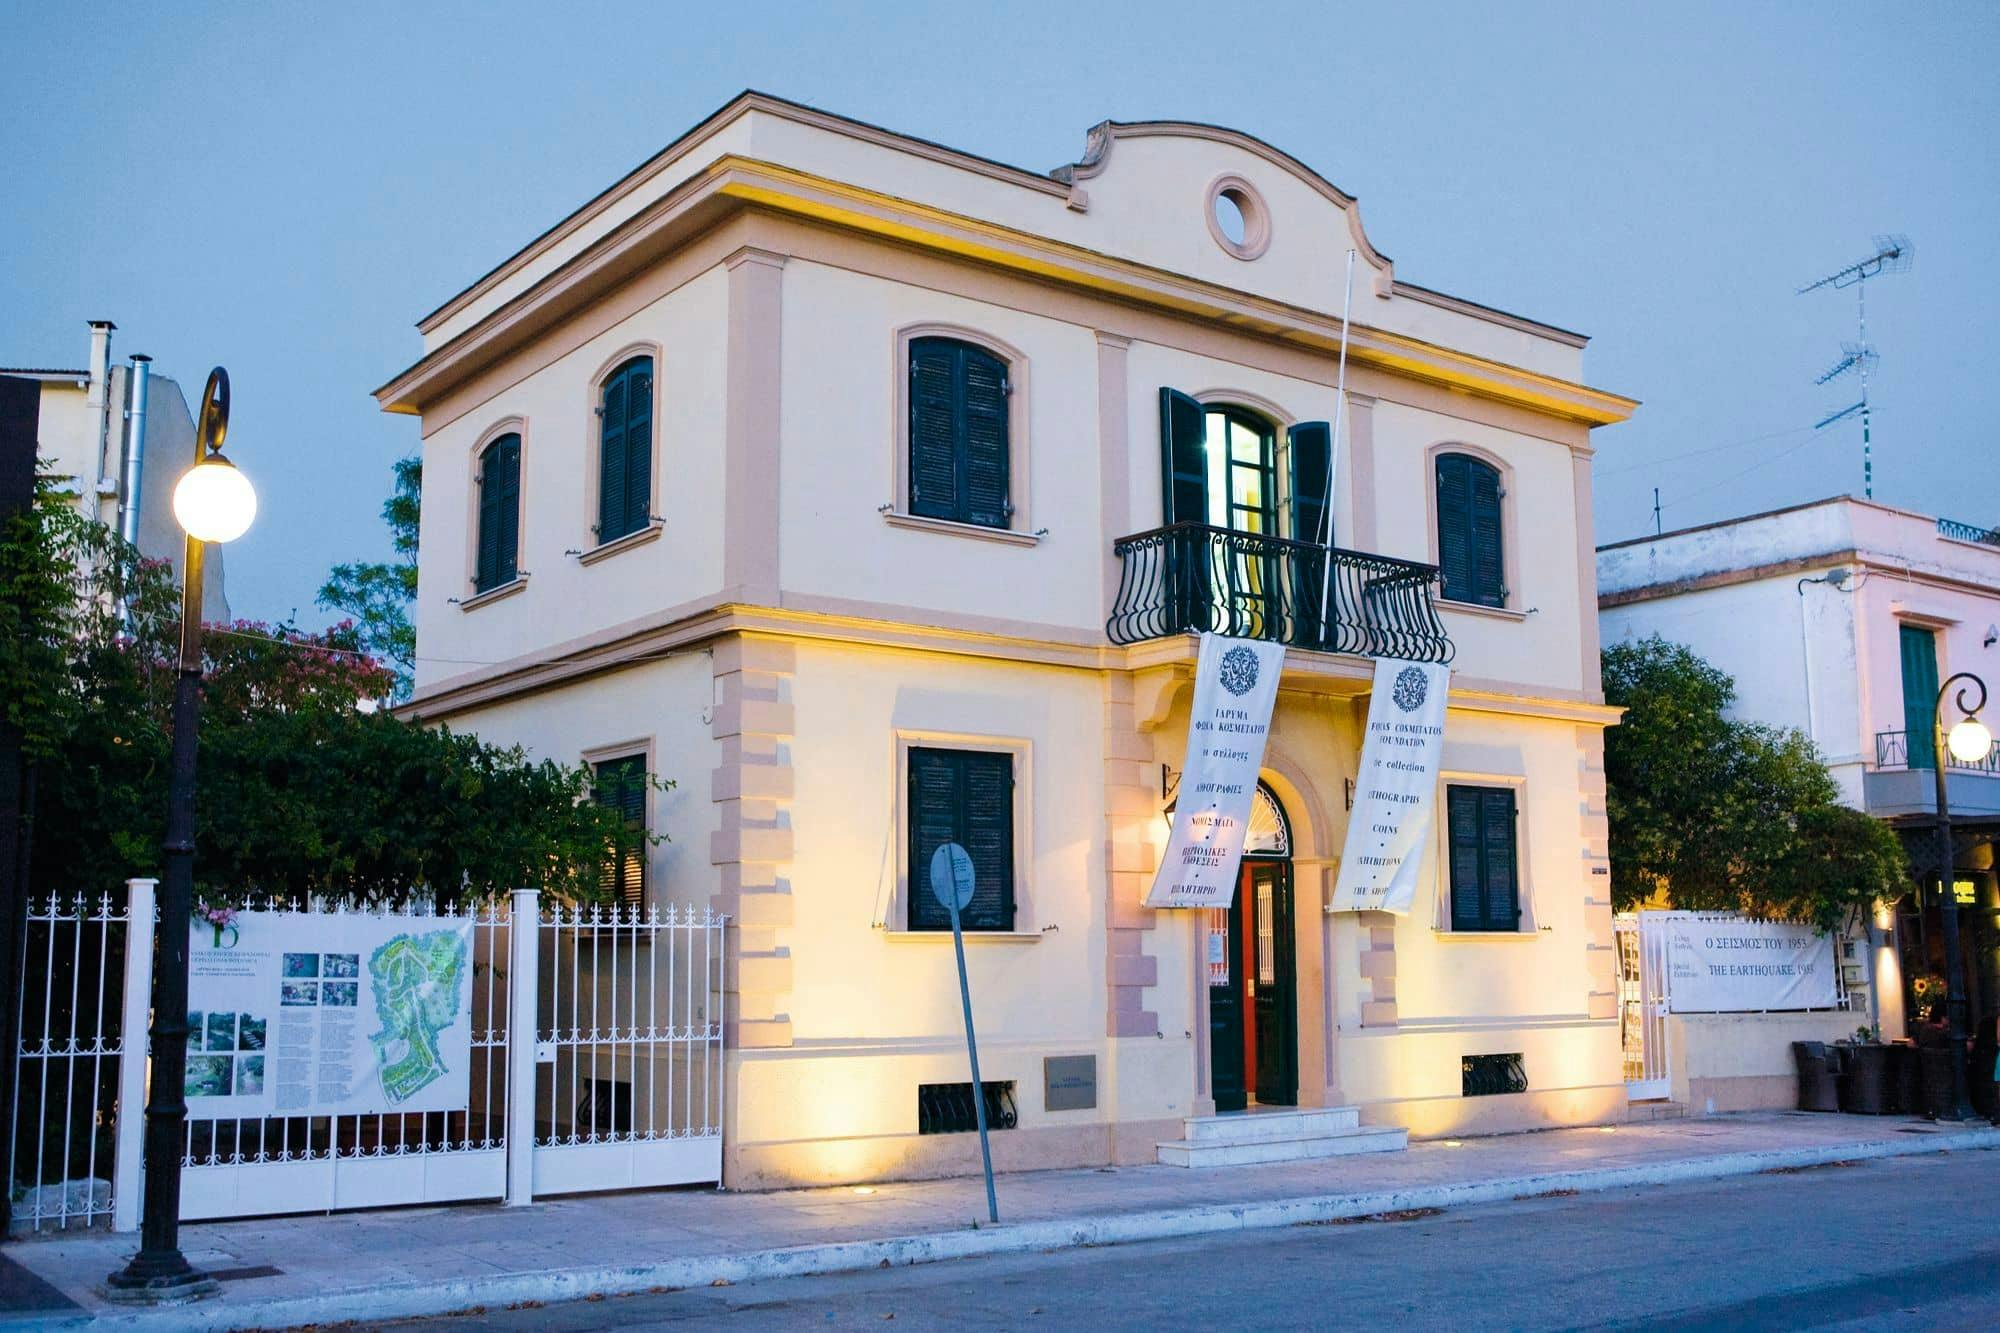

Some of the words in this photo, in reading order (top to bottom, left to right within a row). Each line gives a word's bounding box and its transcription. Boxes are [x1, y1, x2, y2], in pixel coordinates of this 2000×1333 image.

[1717, 937, 1762, 950] ΣΕΙΣΜΟΣ
[1763, 937, 1784, 950] ΤΟΥ
[1709, 964, 1728, 976] THE
